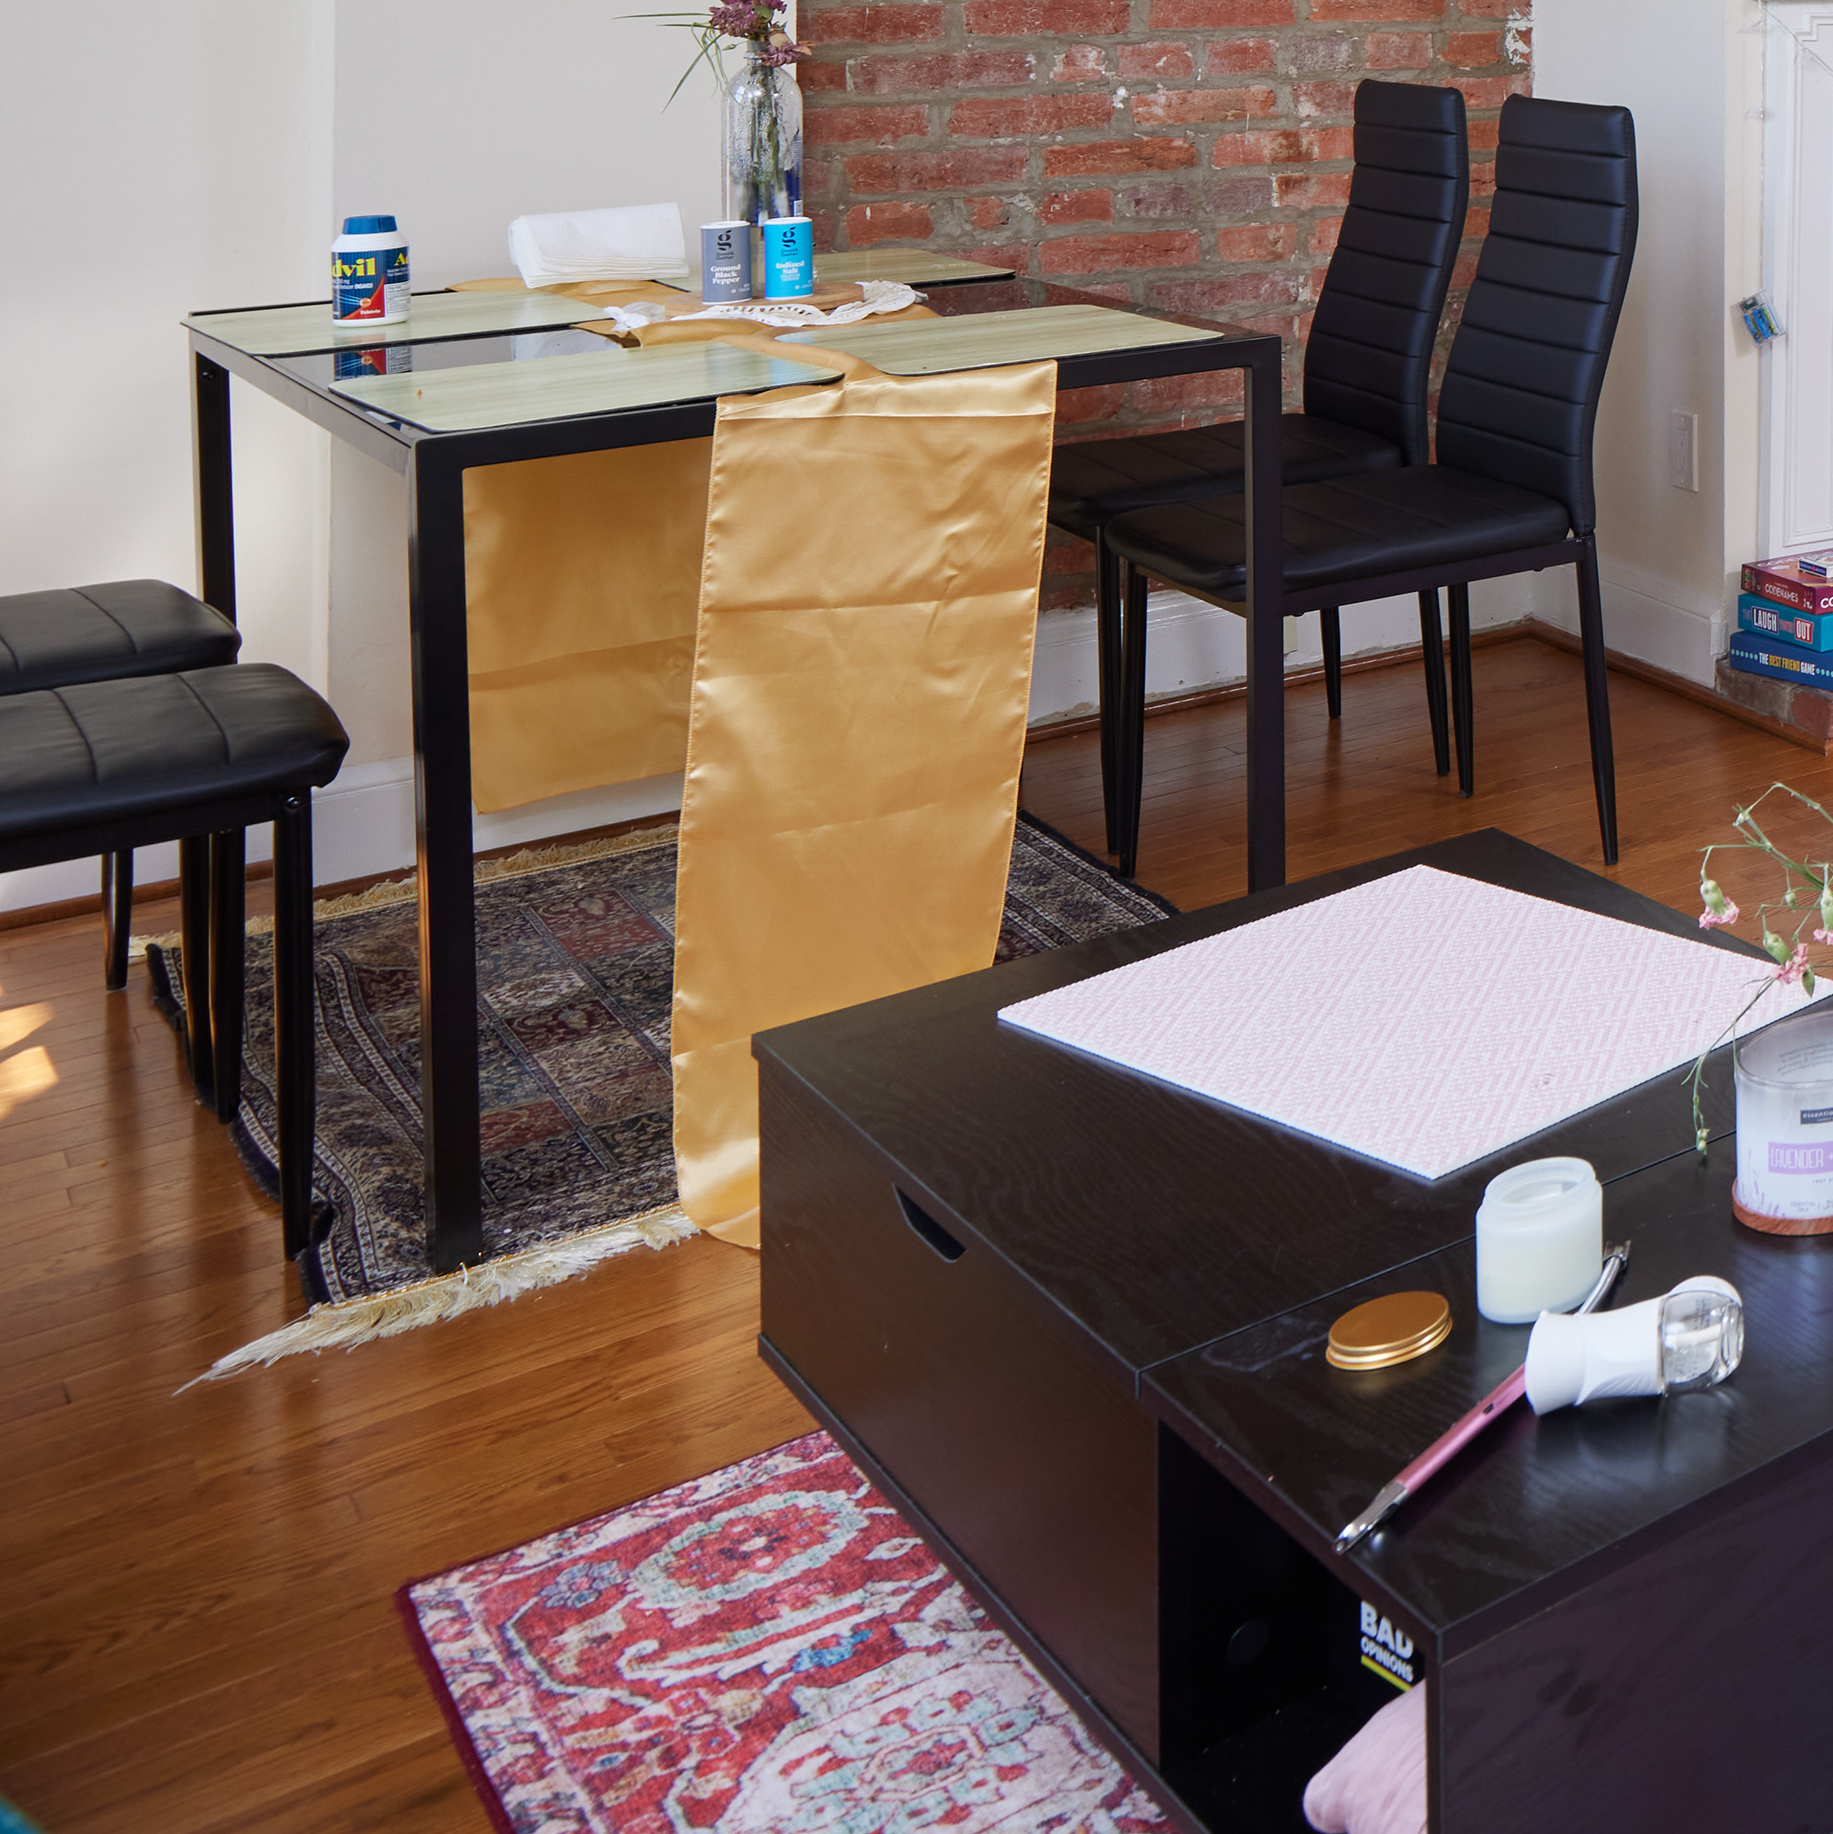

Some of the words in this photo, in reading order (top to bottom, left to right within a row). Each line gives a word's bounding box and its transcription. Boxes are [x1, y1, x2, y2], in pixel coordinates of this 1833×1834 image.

[332, 257, 376, 277] dvil
[711, 264, 741, 272] Ground
[715, 270, 737, 278] Black
[776, 260, 804, 269] Iodized
[712, 276, 740, 285] Pepper
[1765, 584, 1798, 603] CODENAMES
[1753, 608, 1777, 632] LAUGH
[1796, 620, 1811, 641] OUT
[1759, 652, 1768, 665] THE
[1769, 654, 1781, 667] BEST
[1782, 657, 1799, 672] FRIEND
[1800, 661, 1815, 675] GAME
[1770, 1147, 1823, 1169] LAVENDER
[1360, 1635, 1414, 1683] OPINIONS
